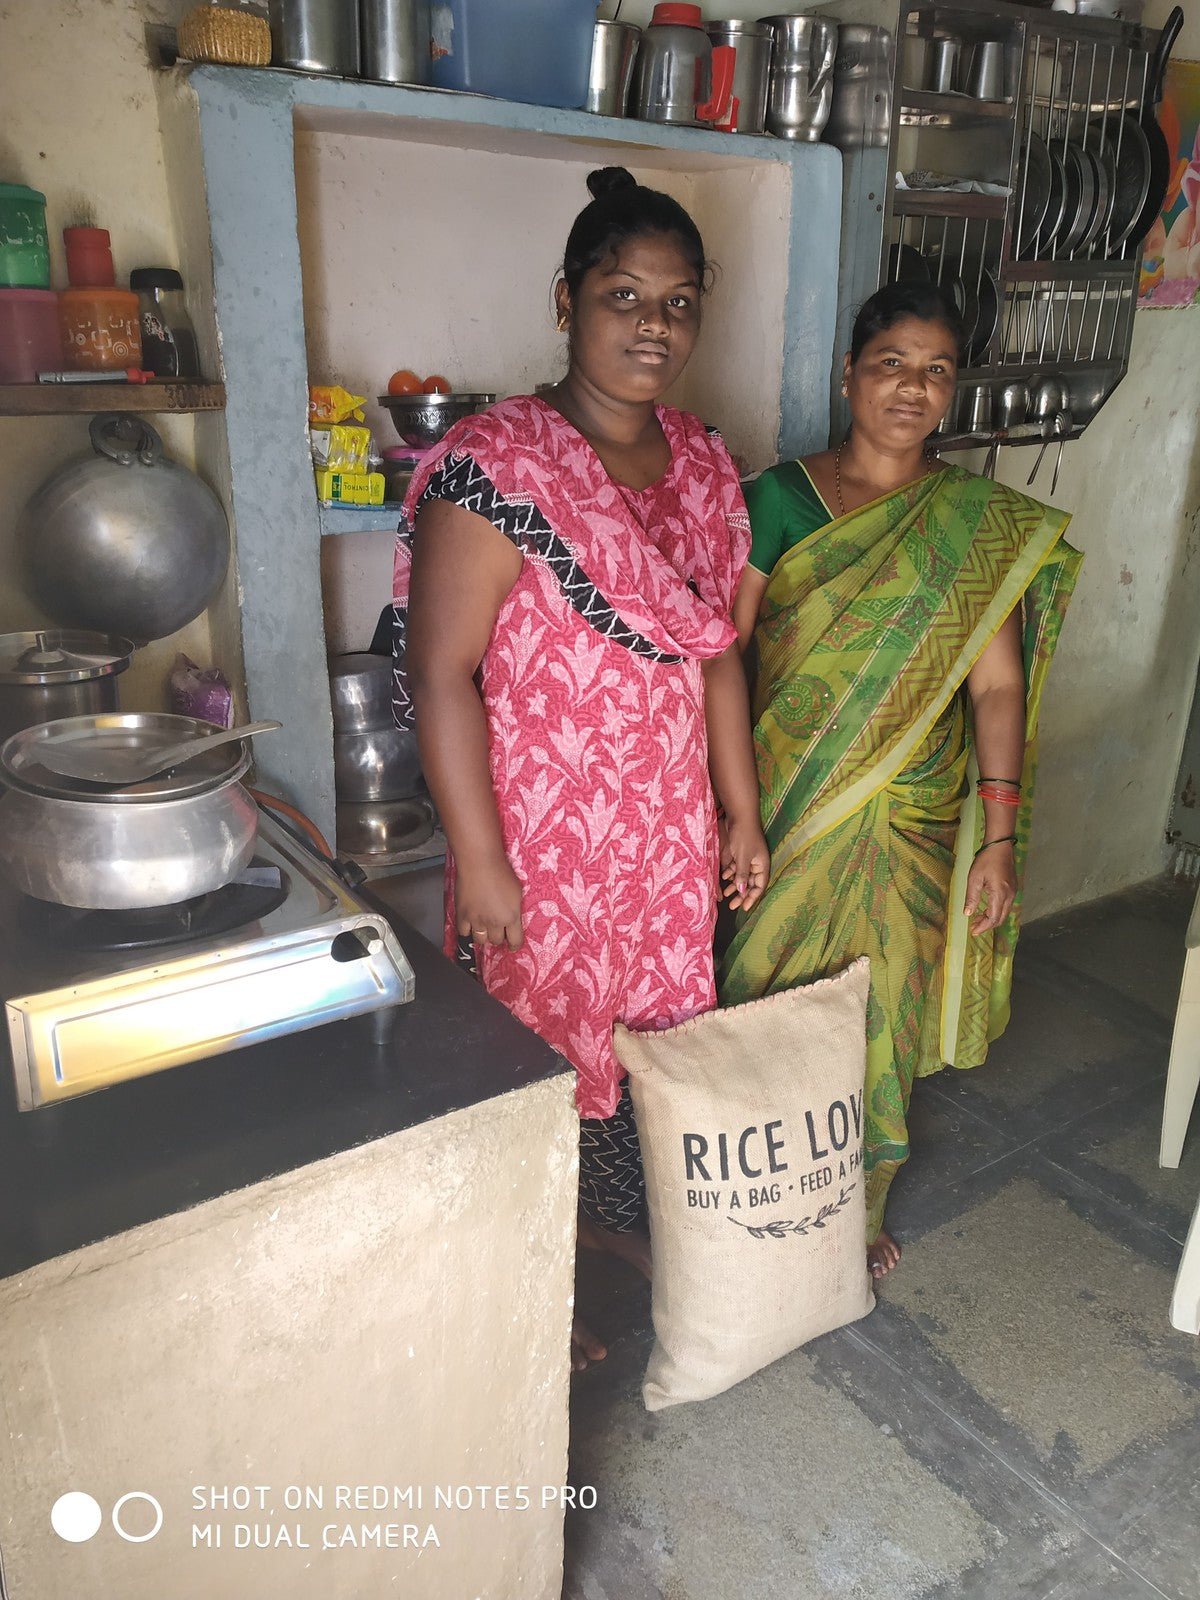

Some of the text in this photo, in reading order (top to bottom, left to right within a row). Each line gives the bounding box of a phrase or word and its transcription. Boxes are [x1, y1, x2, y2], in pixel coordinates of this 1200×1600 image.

[683, 1119, 788, 1181] RICE
[687, 1189, 720, 1209] BUY
[730, 1190, 741, 1209] A
[749, 1183, 781, 1208] BAG
[800, 1166, 832, 1195] FEED
[839, 1160, 846, 1180] A
